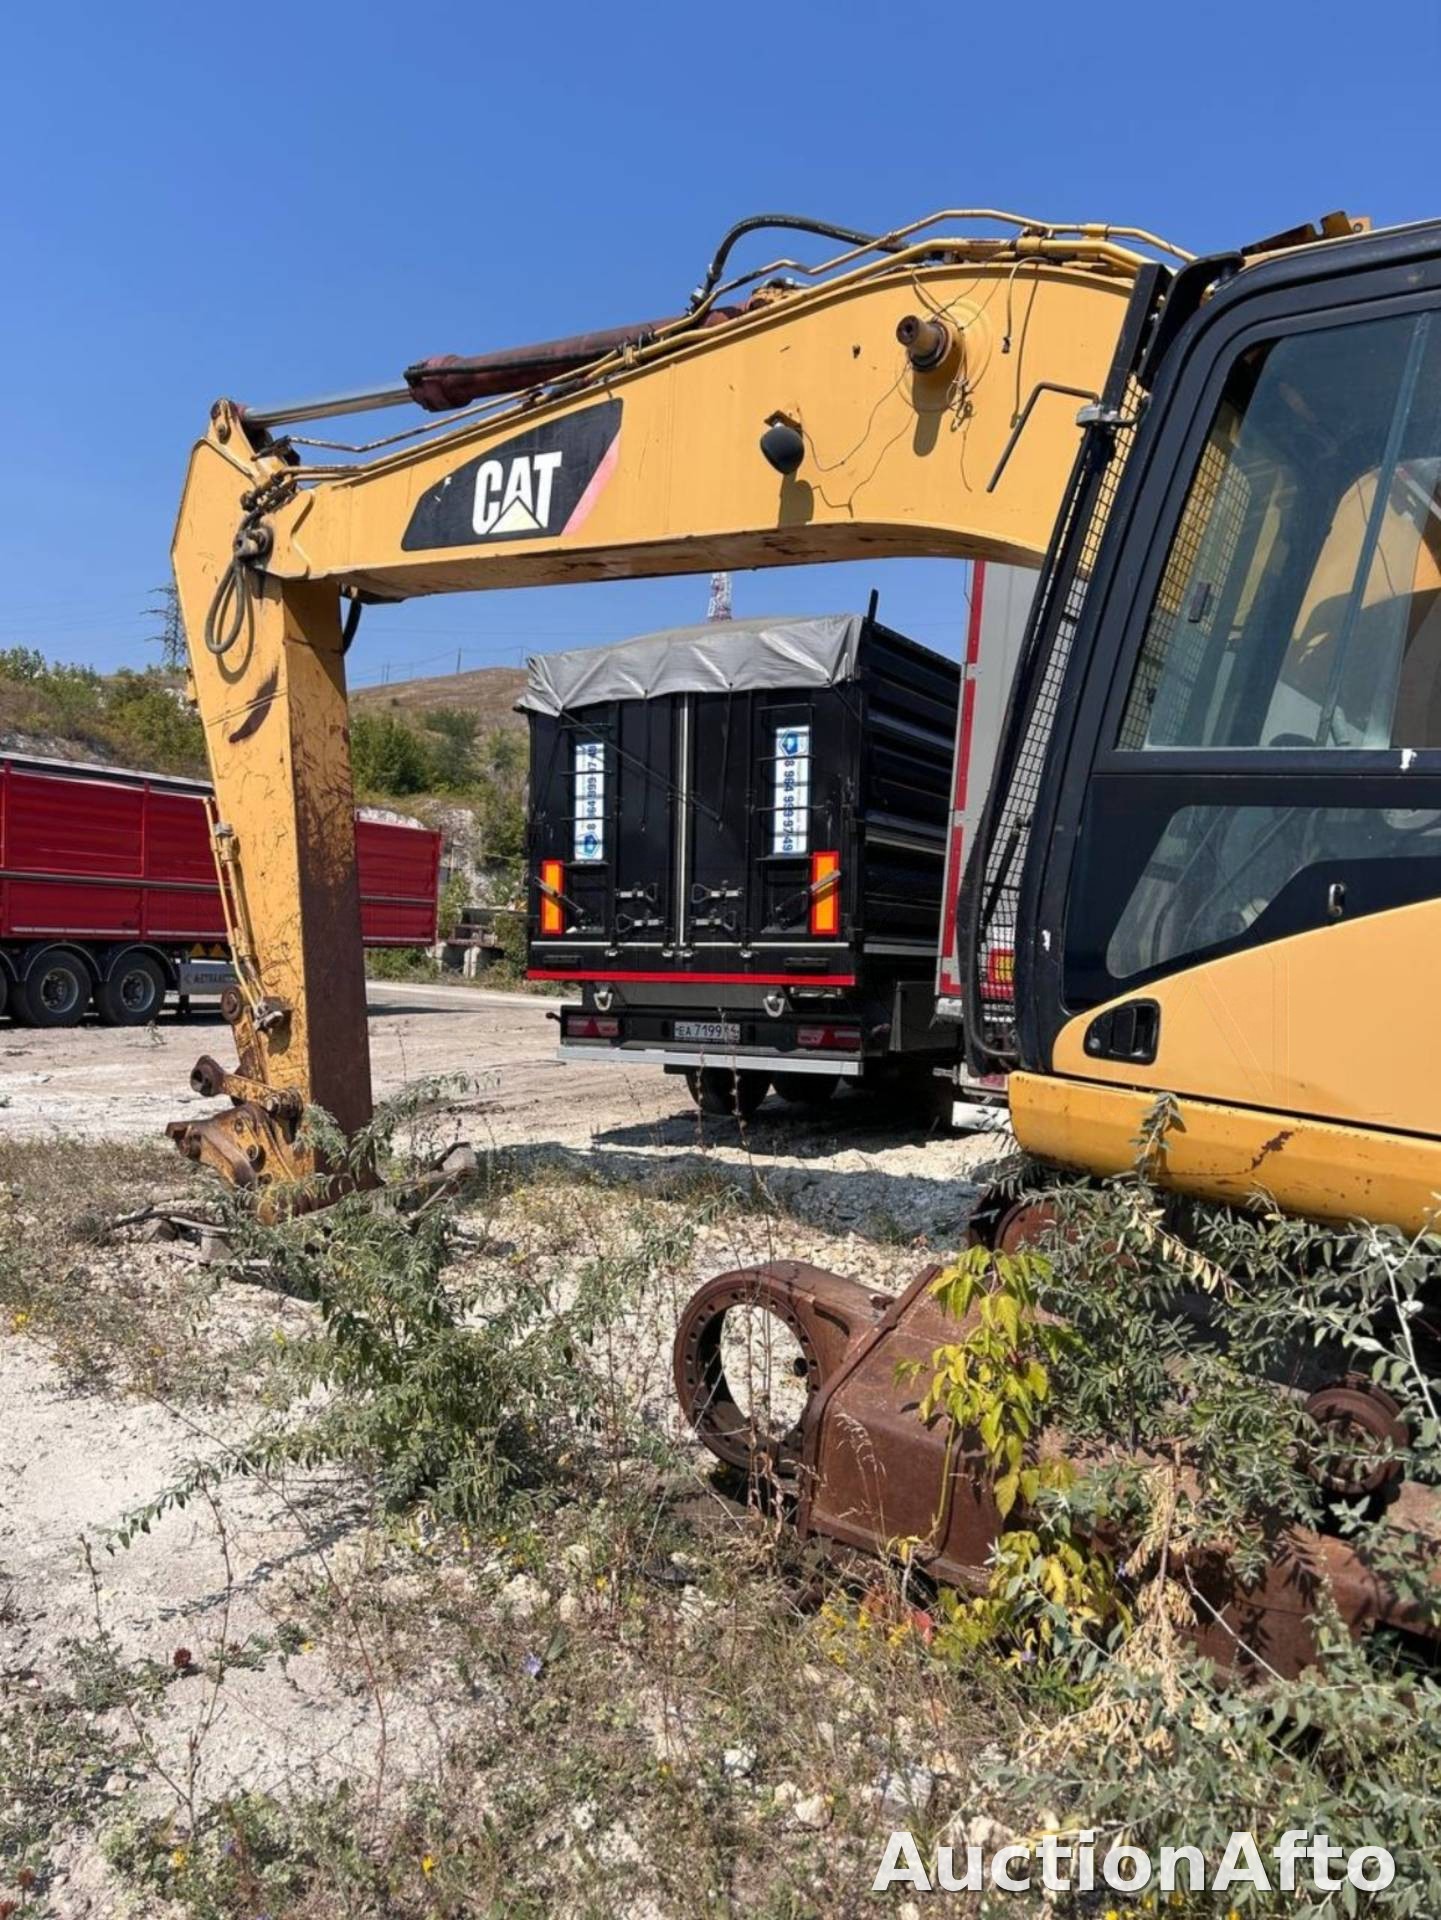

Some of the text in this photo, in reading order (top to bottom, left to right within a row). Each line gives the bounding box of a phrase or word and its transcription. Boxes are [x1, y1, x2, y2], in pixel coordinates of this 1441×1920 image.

[473, 450, 562, 535] CAT
[784, 759, 795, 767] 8
[587, 823, 597, 831] 8
